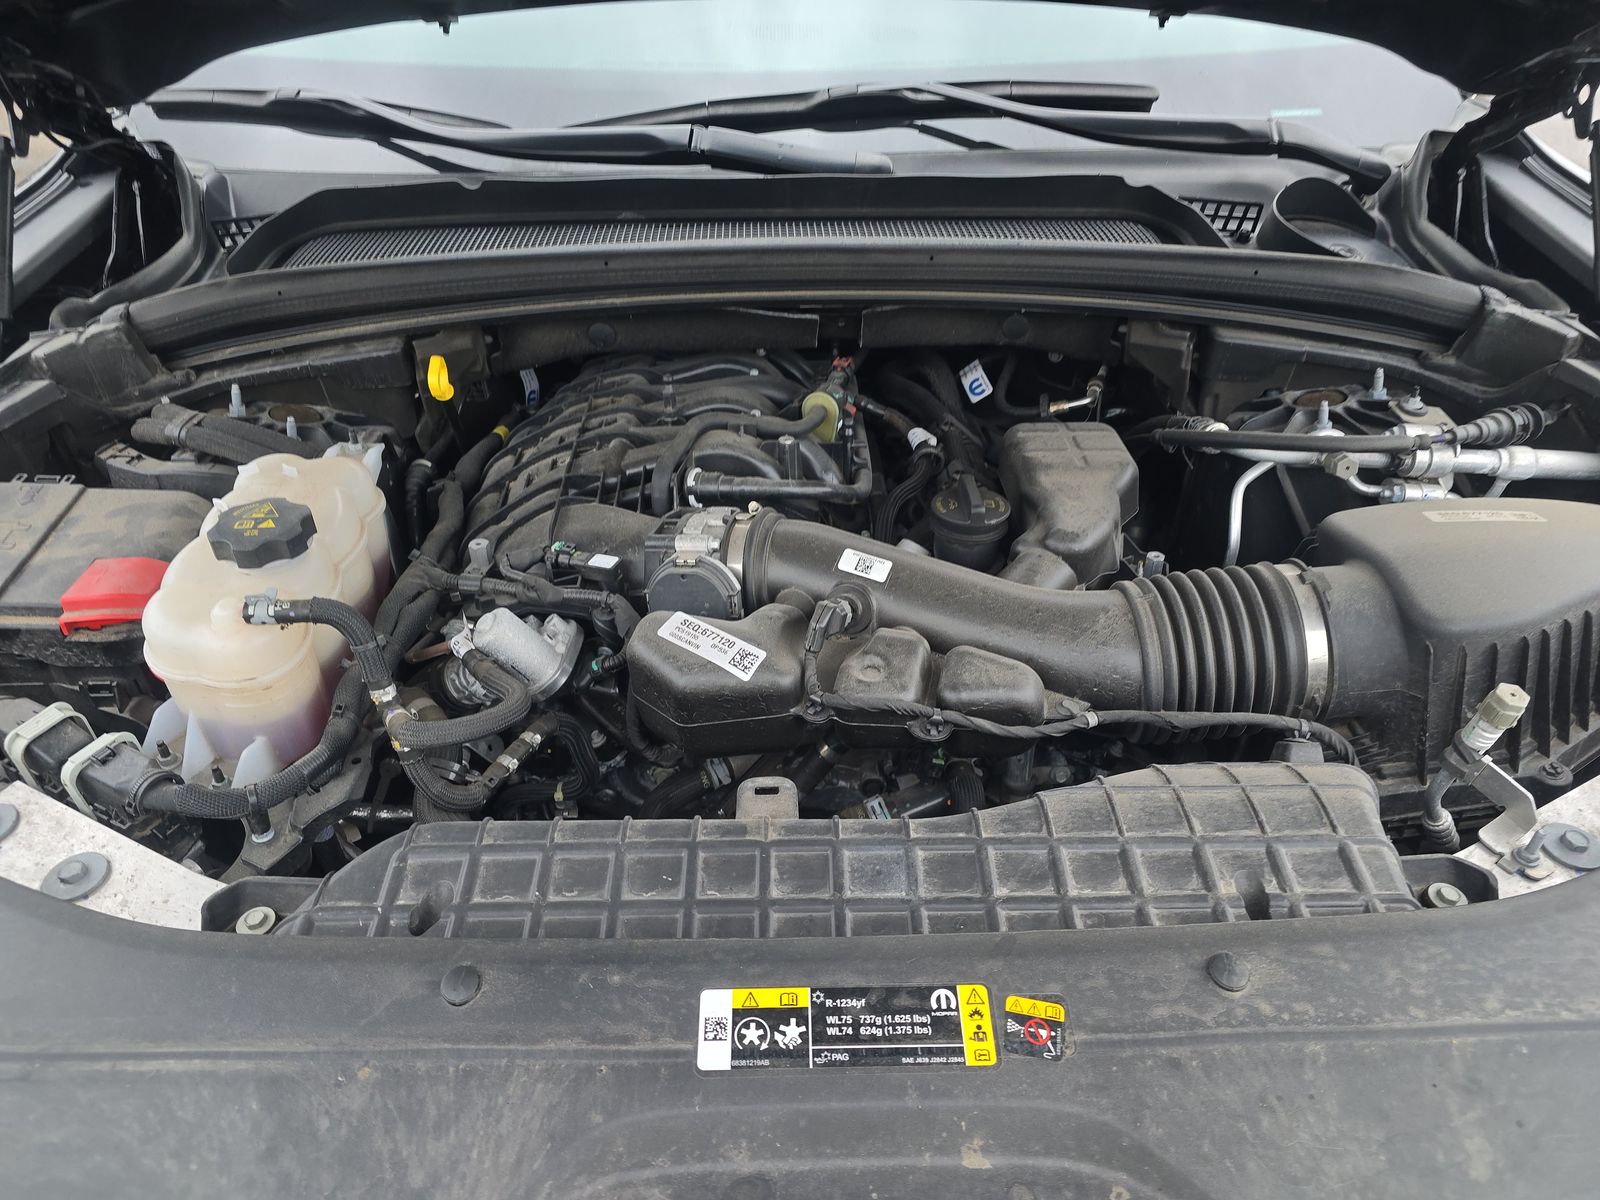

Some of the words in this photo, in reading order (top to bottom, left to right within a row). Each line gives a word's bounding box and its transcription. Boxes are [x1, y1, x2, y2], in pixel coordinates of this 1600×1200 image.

[680, 618, 736, 649] SEQ:677120
[825, 998, 866, 1009] R-1234yf
[825, 1015, 853, 1025] WL75
[859, 1015, 882, 1026] 737g
[883, 1014, 912, 1025] (1.625
[912, 1014, 931, 1025] lbs)
[826, 1026, 853, 1036] WL74
[859, 1026, 883, 1037] 624g
[884, 1025, 913, 1036] (1.375
[913, 1025, 933, 1036] lbs)
[831, 1052, 850, 1061] PAG
